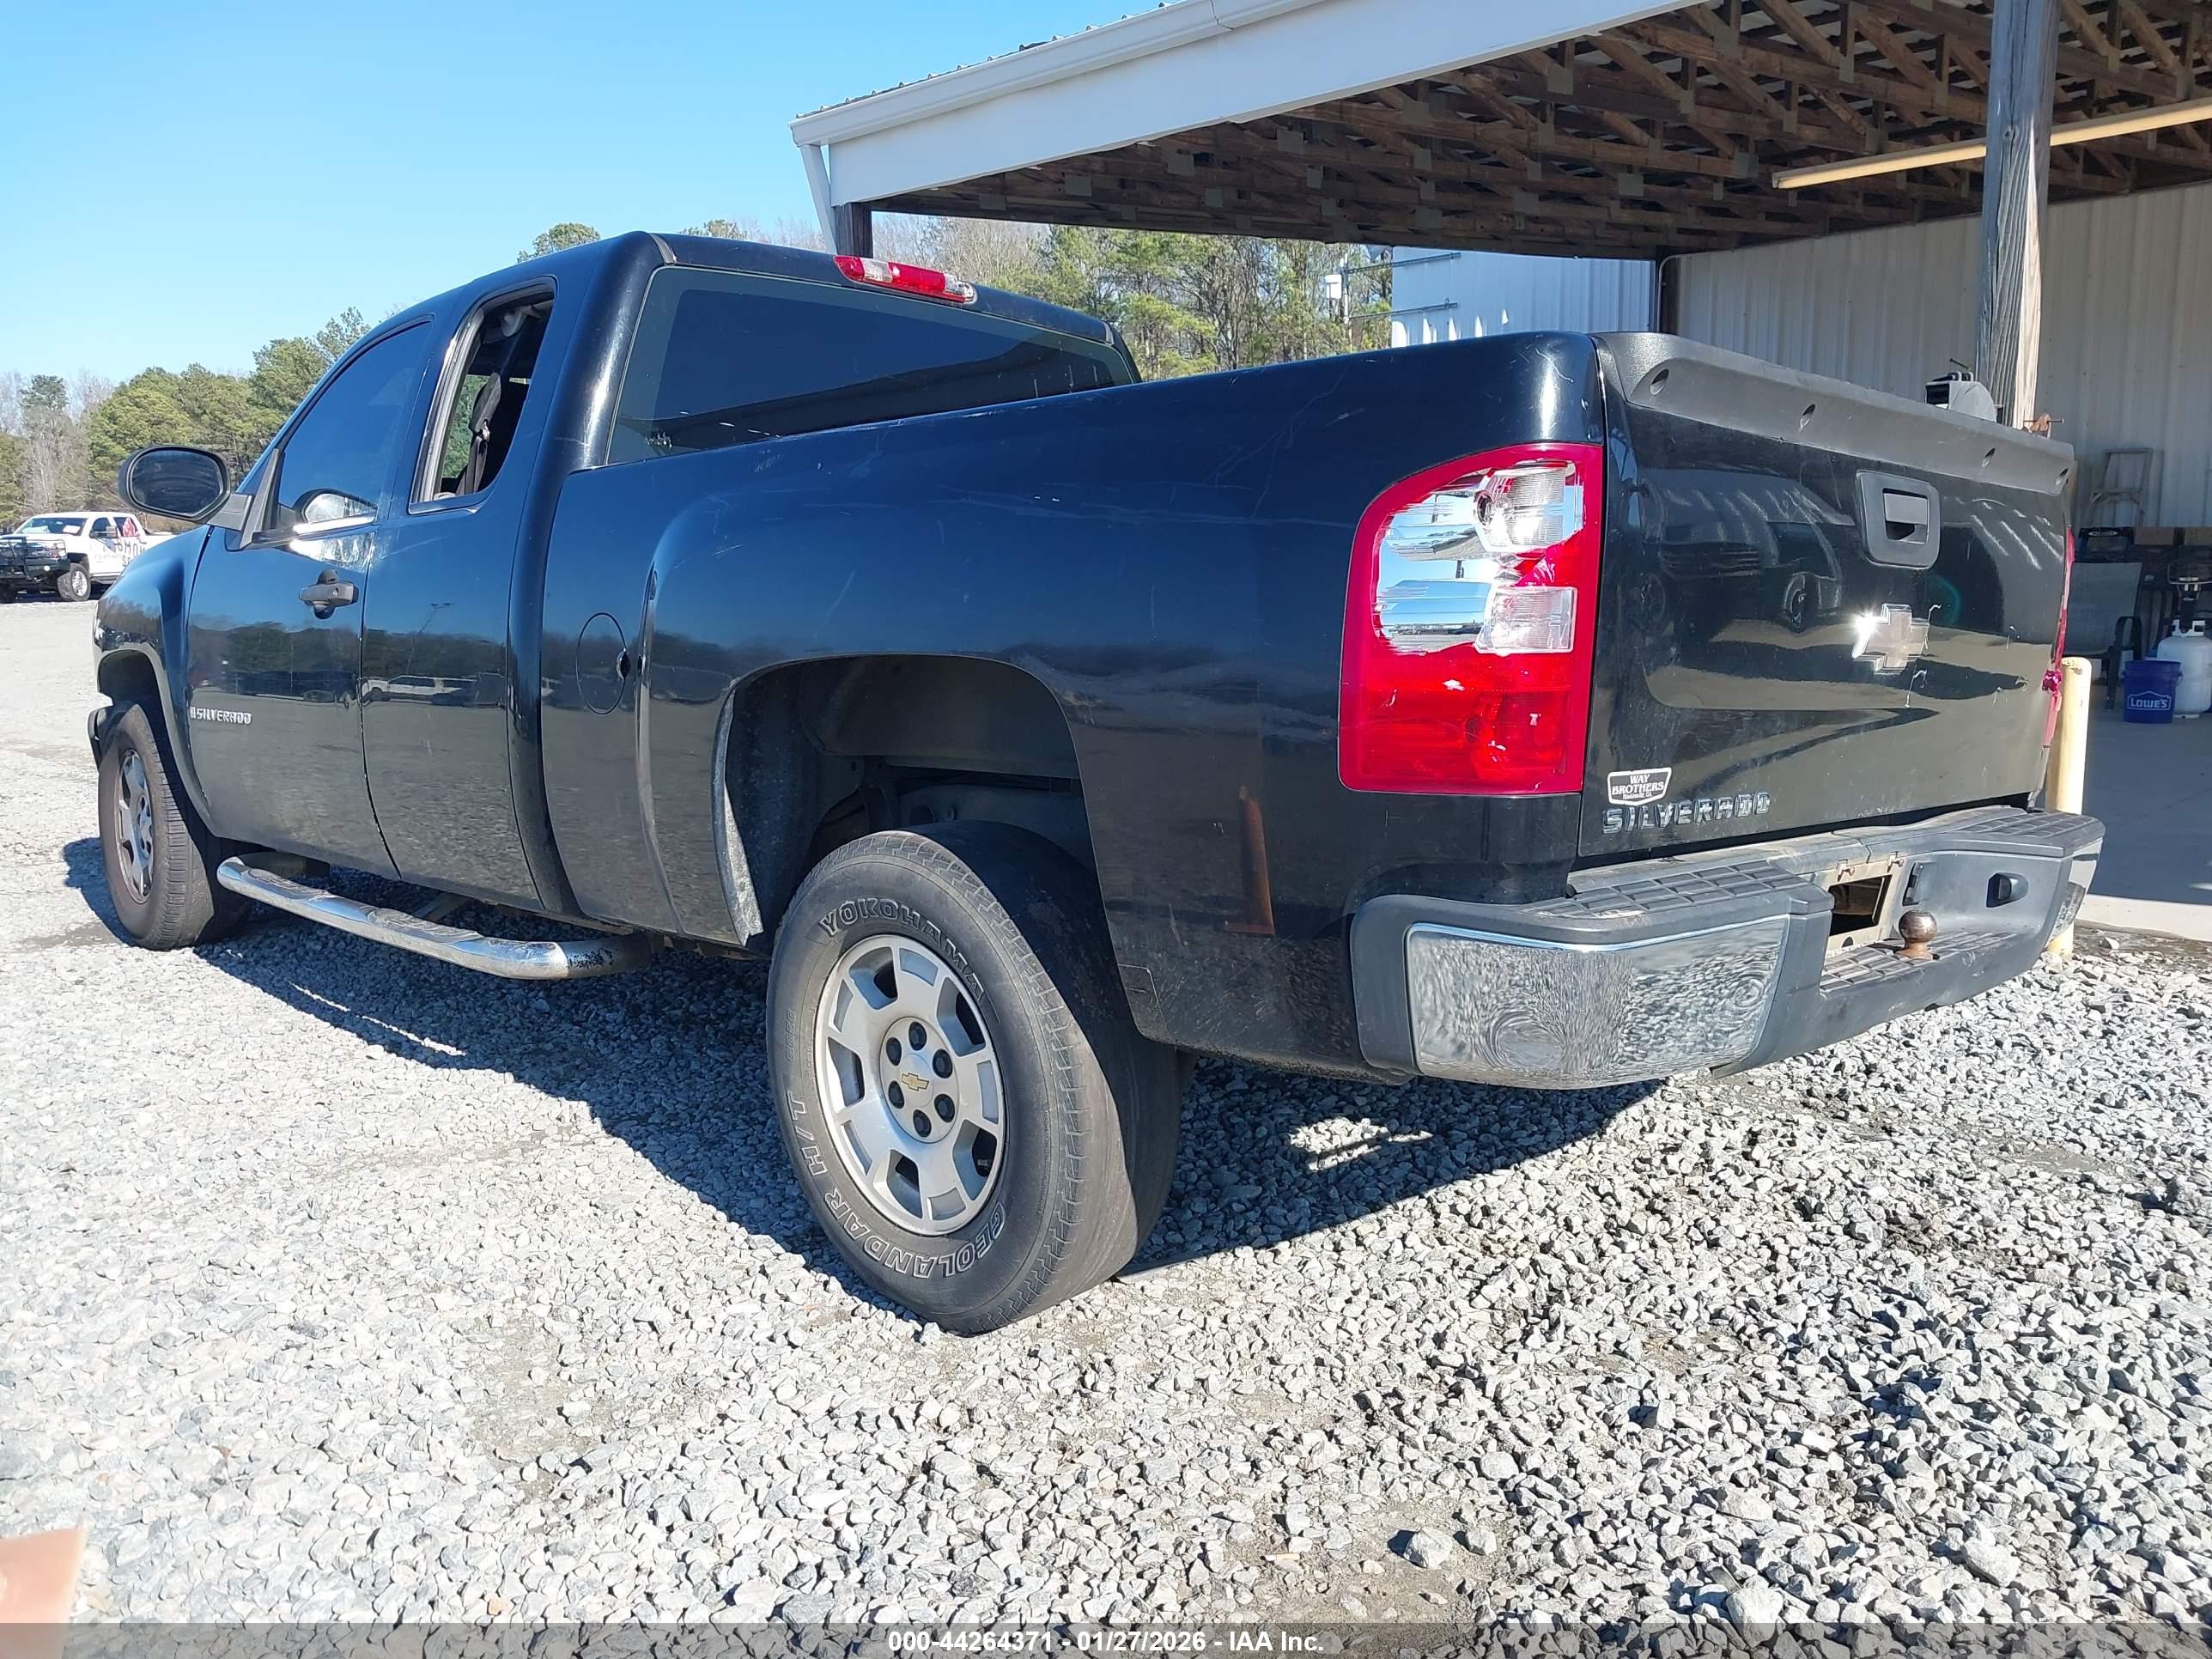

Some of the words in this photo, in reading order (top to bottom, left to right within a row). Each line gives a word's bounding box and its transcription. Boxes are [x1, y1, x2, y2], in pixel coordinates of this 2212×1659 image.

[196, 708, 252, 725] SILVERADO
[1612, 781, 1664, 795] BROTHERS
[1630, 774, 1650, 784] WAY
[1602, 792, 1771, 835] SILVERADO
[818, 896, 985, 1004] YOKOHAMA
[787, 1091, 828, 1176] H/T
[824, 1188, 1006, 1279] GEOLANDAR
